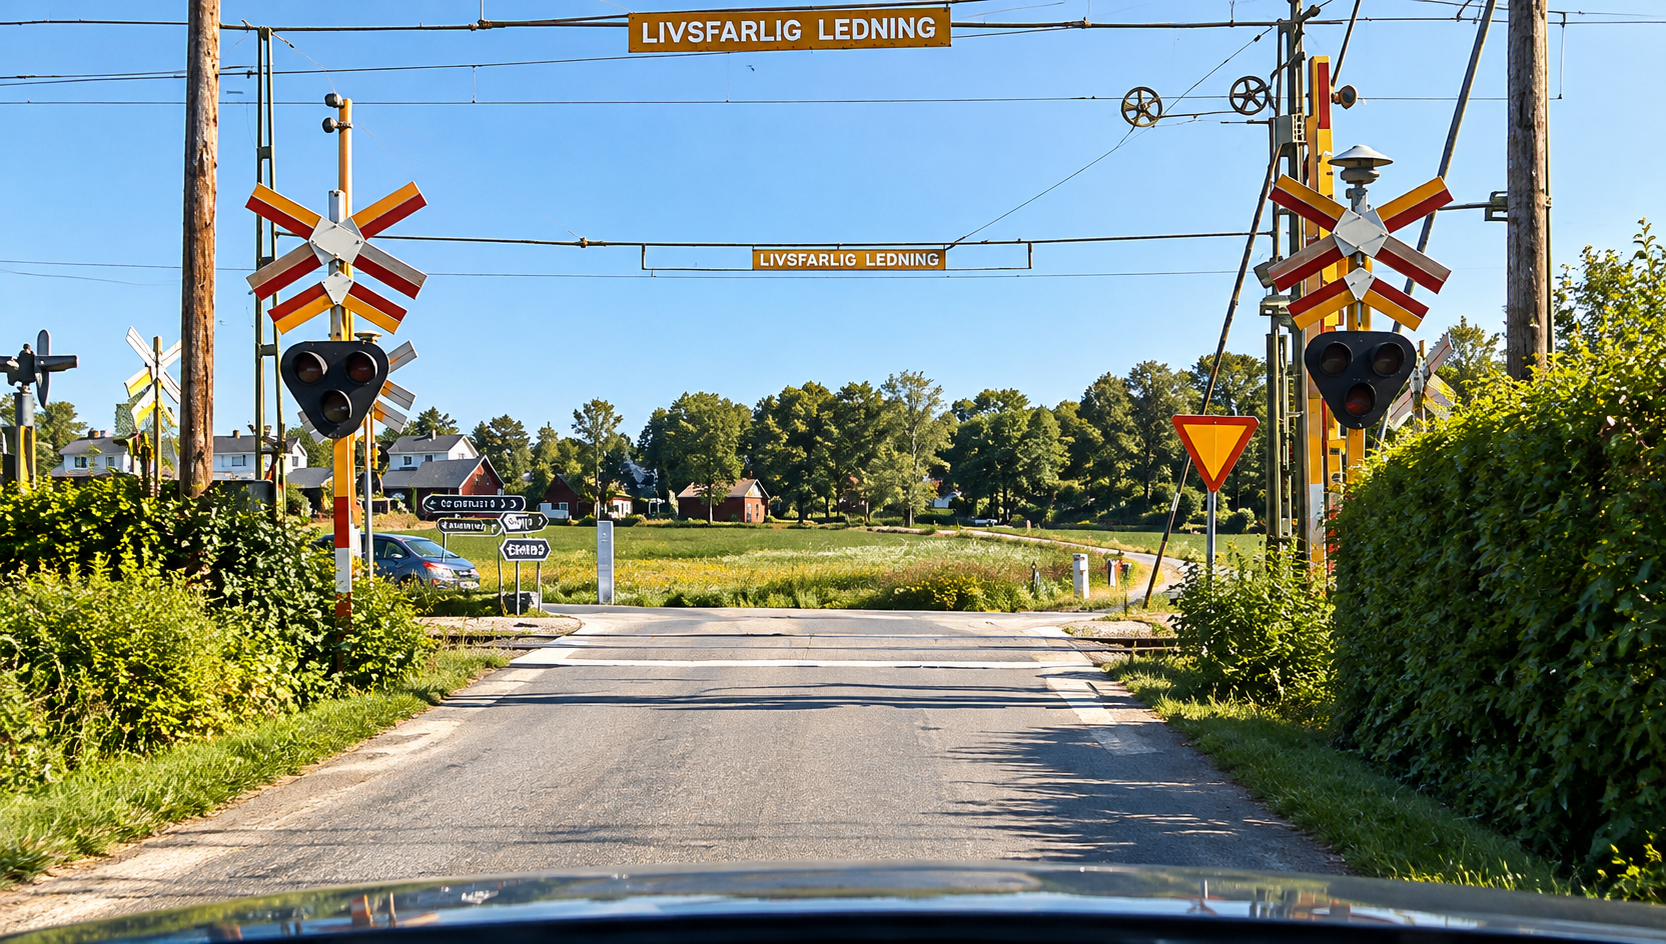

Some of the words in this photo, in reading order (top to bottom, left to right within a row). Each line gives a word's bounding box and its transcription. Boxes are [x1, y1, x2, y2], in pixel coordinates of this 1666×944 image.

[642, 19, 802, 43] LIVSFARLIG
[818, 16, 936, 41] LEDNING
[760, 253, 857, 267] LIVSFARLIG
[865, 253, 940, 267] LEDNING
